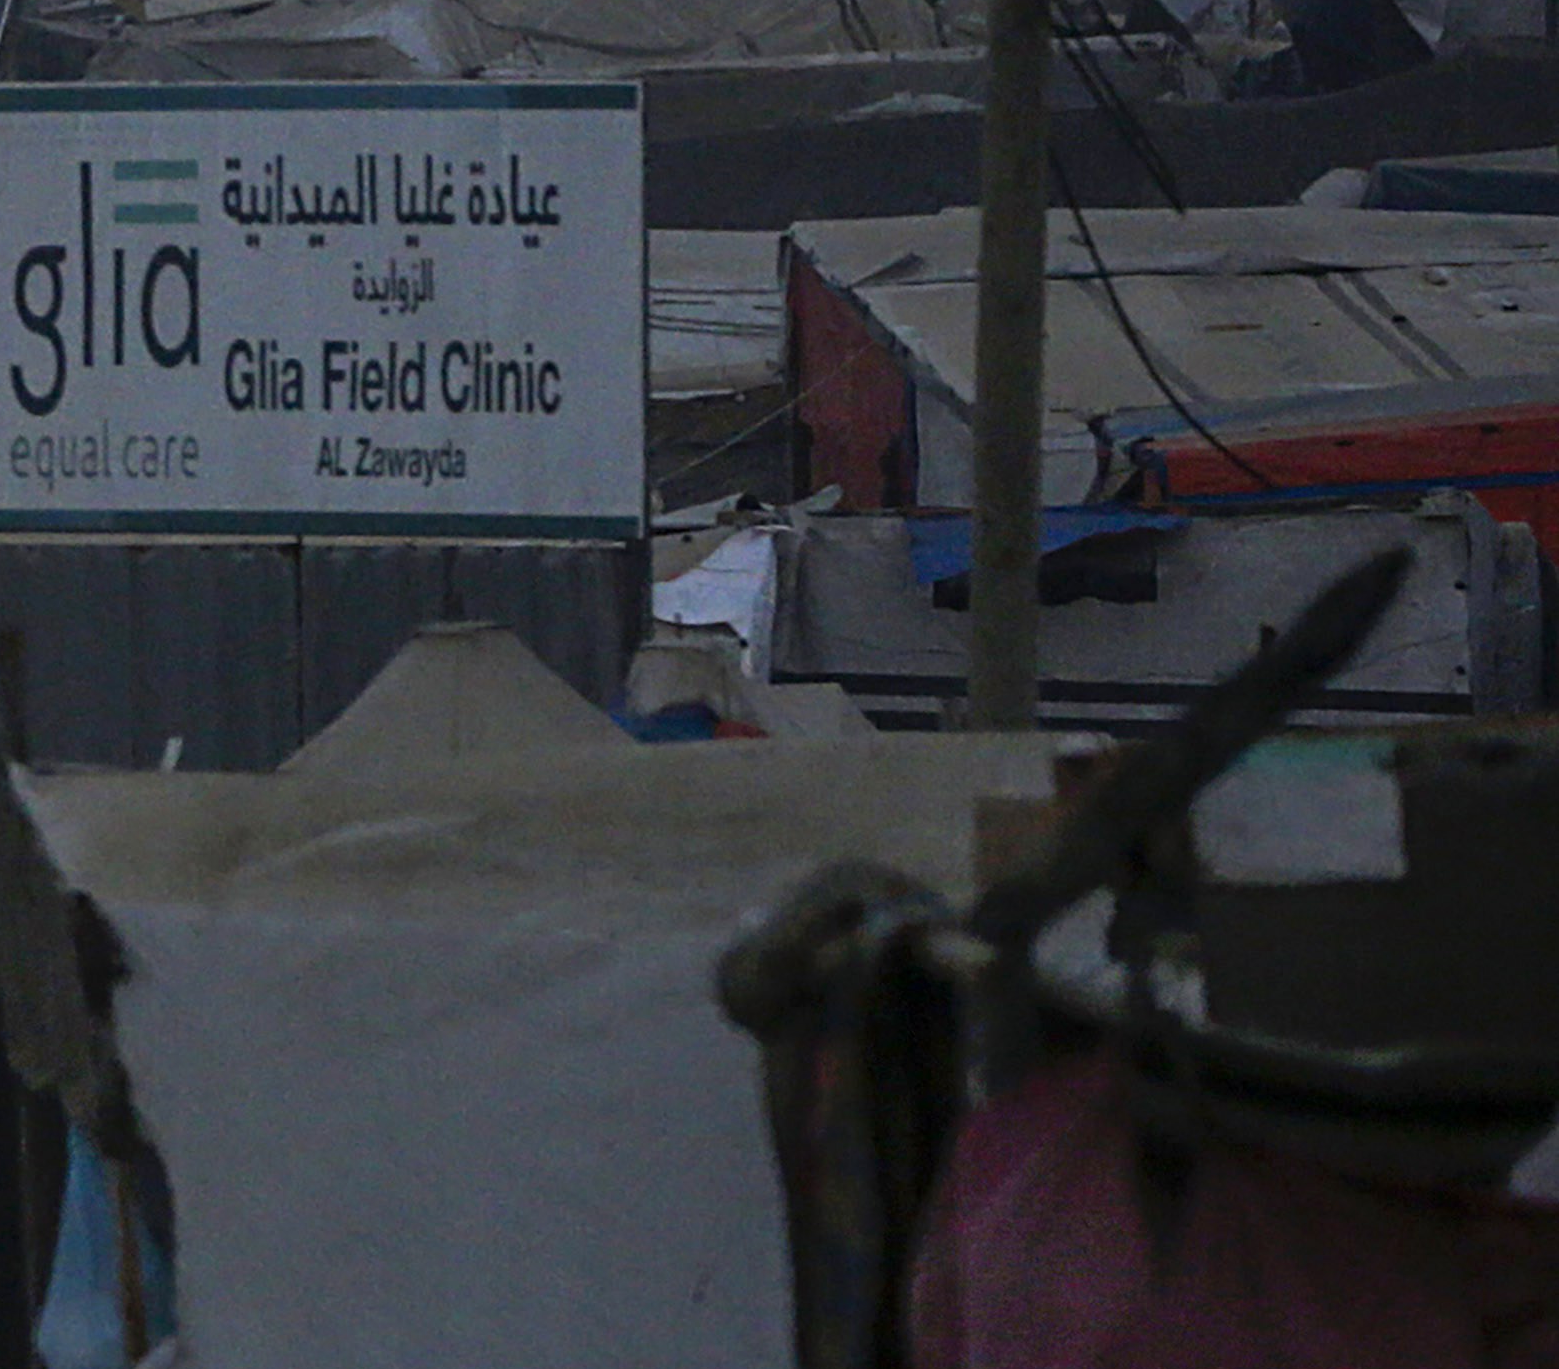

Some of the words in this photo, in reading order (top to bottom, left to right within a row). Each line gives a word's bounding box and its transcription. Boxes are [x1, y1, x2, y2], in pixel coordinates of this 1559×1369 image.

[222, 154, 377, 247] الميدانية
[394, 154, 455, 247] غليا
[470, 155, 561, 248] عيادة
[10, 161, 200, 416] glia
[353, 258, 435, 315] الزوايدة
[224, 340, 304, 412] Glia
[322, 342, 425, 412] Field
[441, 341, 562, 416] Clinic
[9, 421, 112, 492] equal
[122, 434, 200, 479] care
[354, 439, 467, 486] Zawayda
